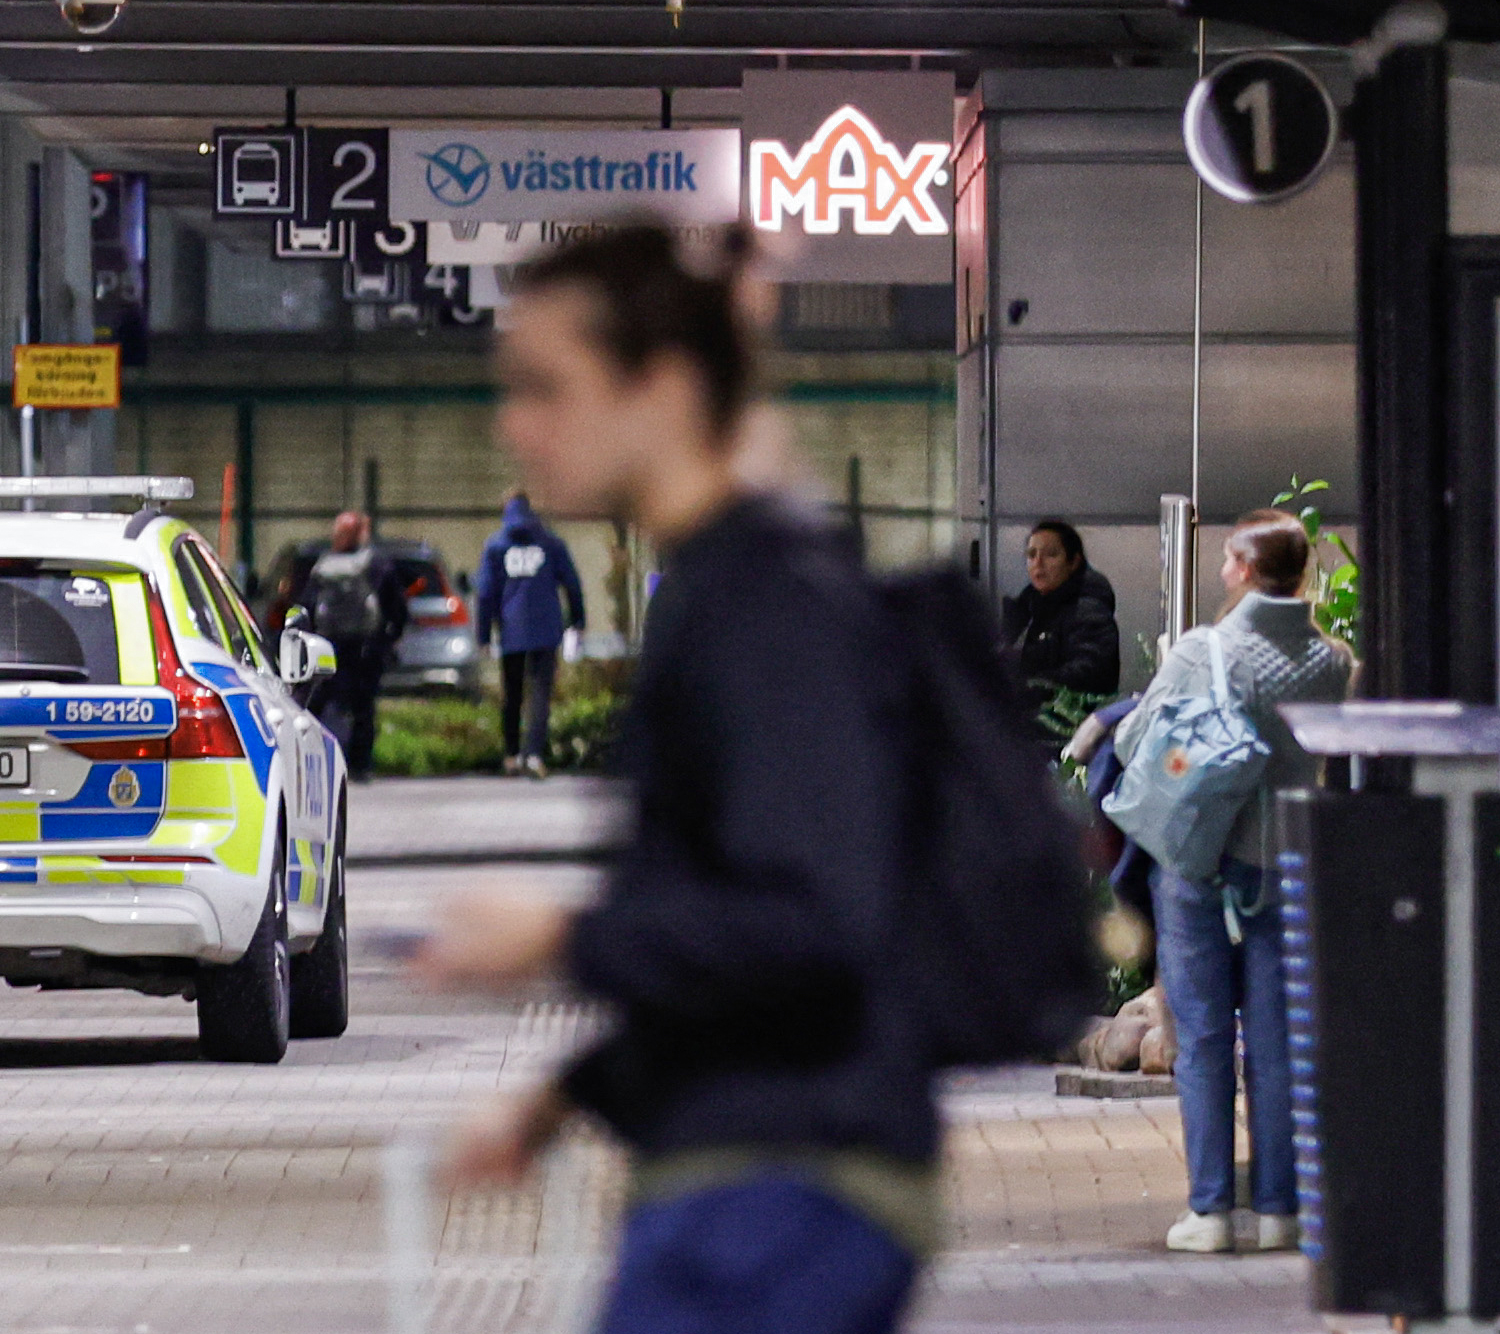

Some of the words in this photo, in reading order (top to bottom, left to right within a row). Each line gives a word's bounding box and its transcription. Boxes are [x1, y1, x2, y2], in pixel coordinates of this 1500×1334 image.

[1233, 80, 1274, 174] 1
[330, 140, 378, 210] 2
[500, 150, 699, 192] västtrafik
[750, 103, 951, 235] MAX
[46, 703, 57, 722] 1
[65, 700, 155, 723] 59-2120
